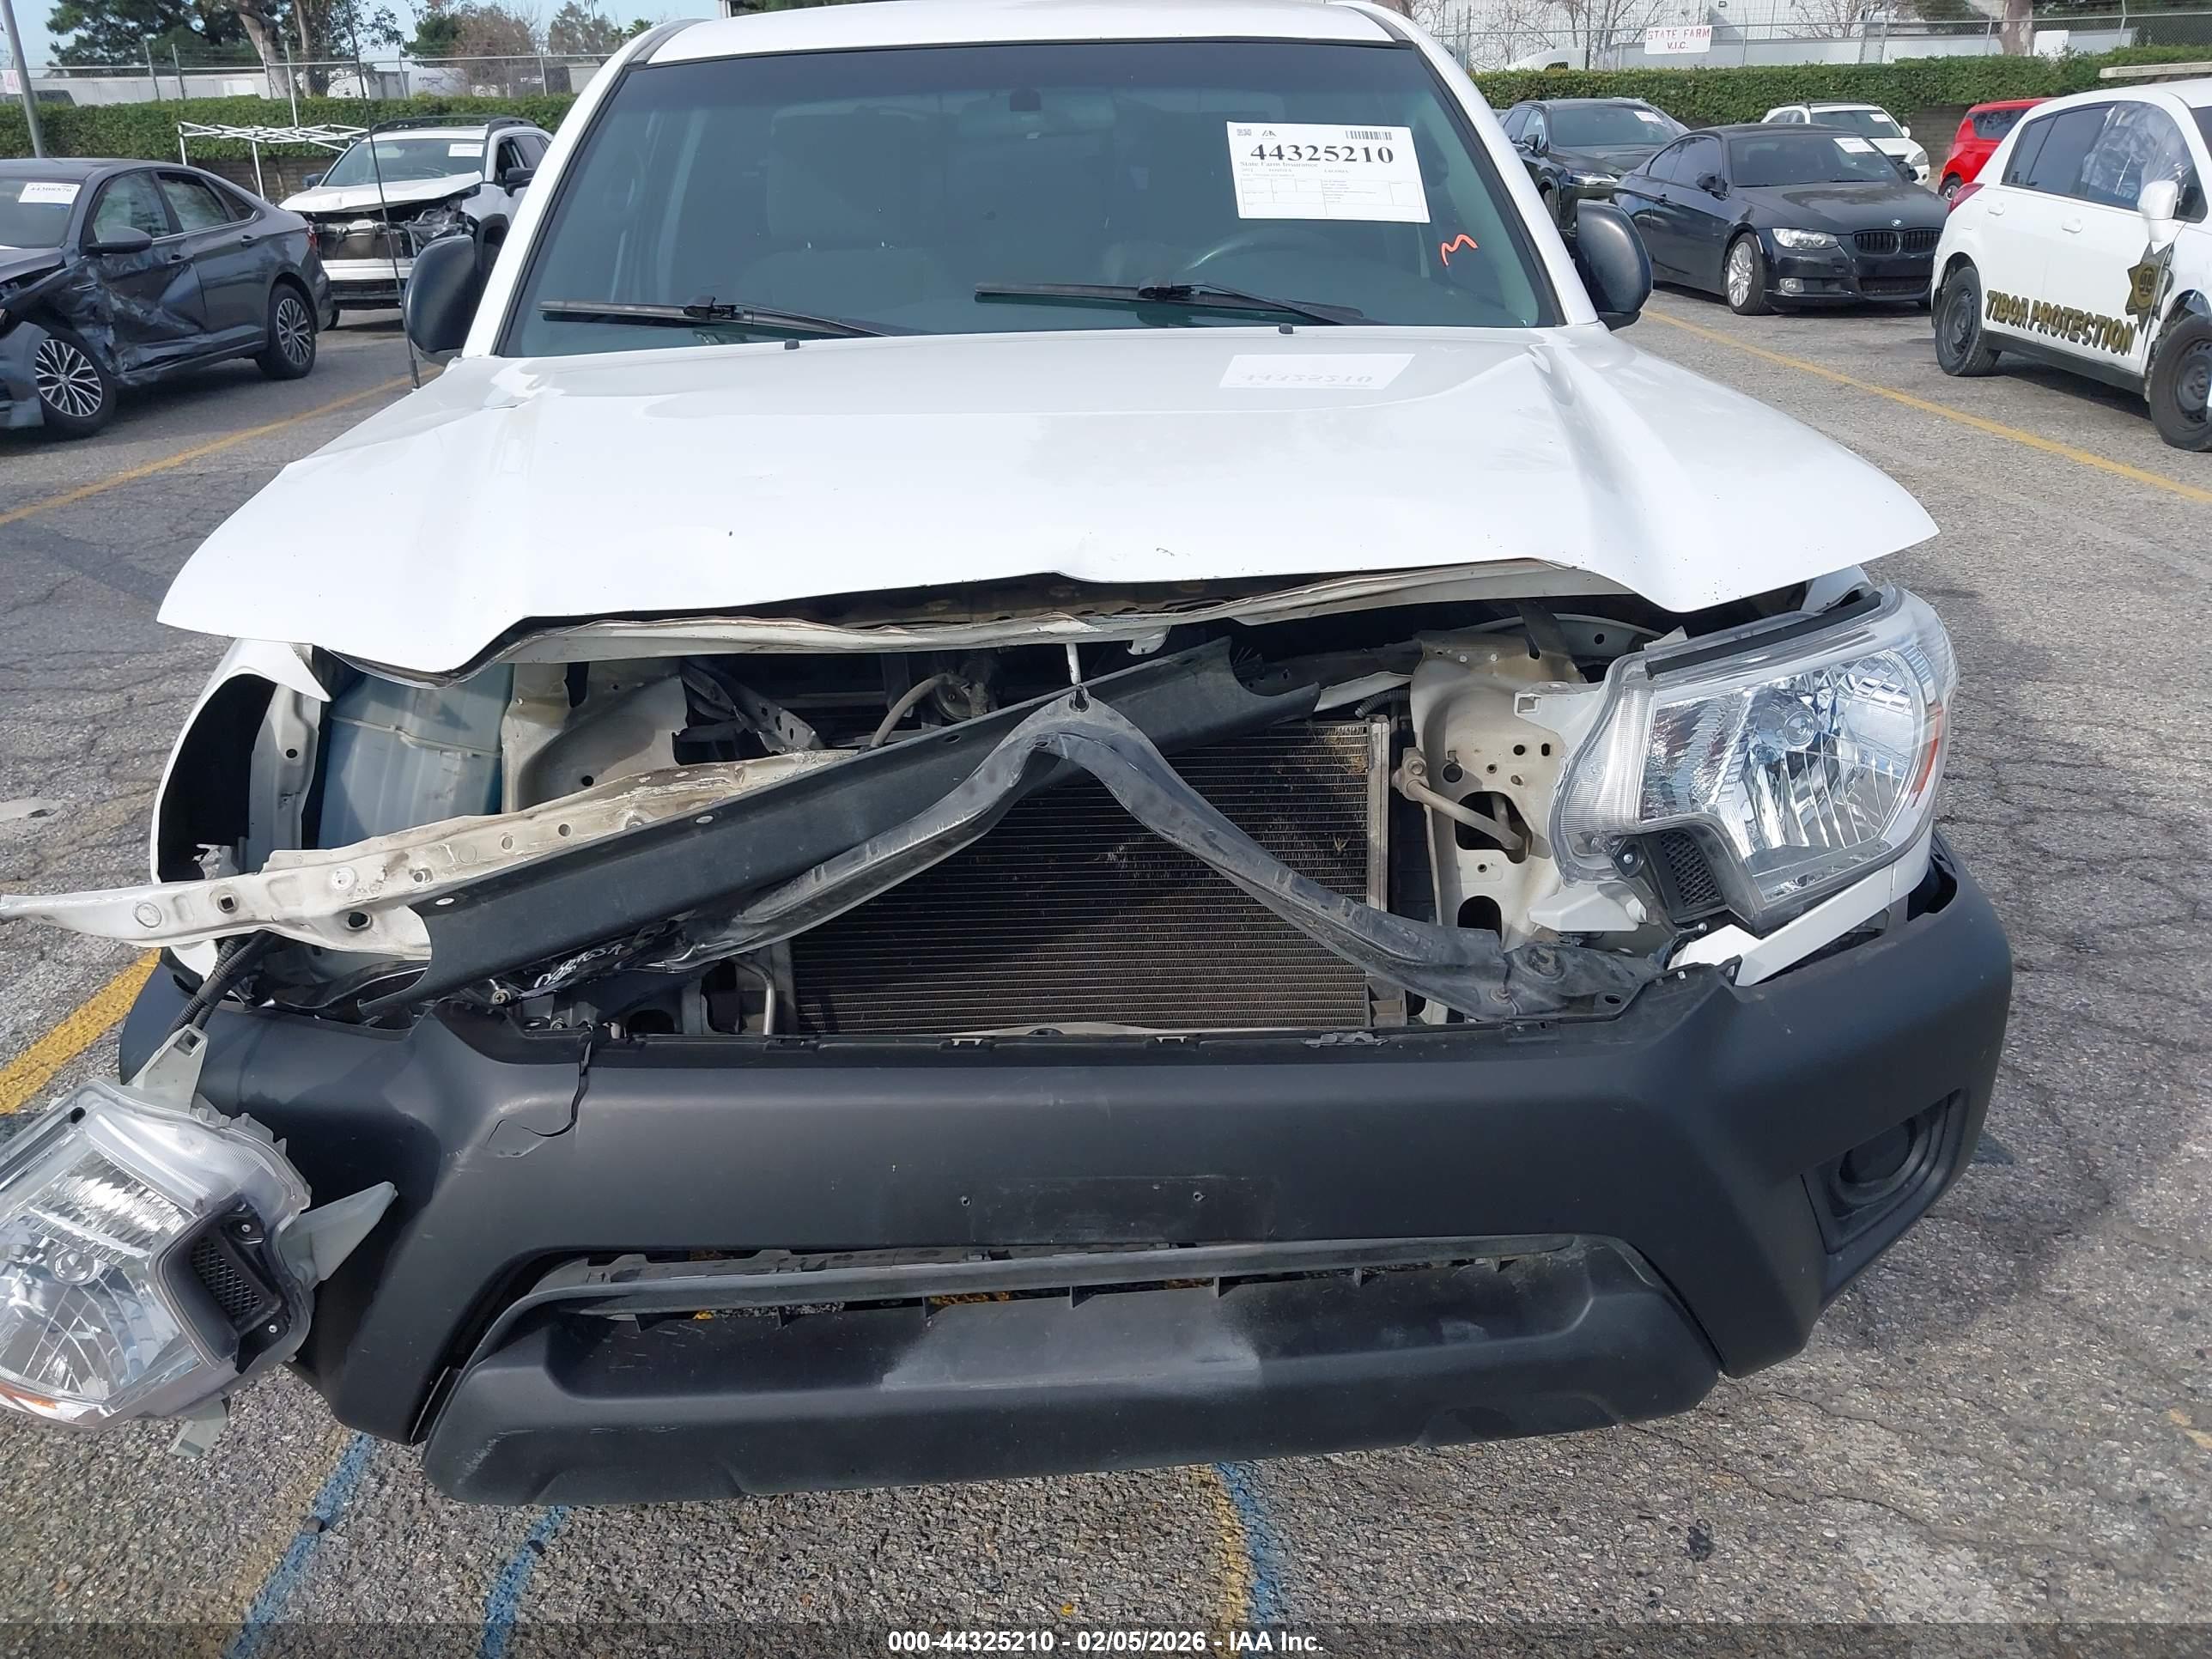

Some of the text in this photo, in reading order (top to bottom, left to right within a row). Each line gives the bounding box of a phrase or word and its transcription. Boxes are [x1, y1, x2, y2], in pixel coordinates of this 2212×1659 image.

[1647, 27, 1711, 40] STATE FARM
[1250, 143, 1395, 163] 44325210
[2027, 300, 2140, 356] PROTECTION
